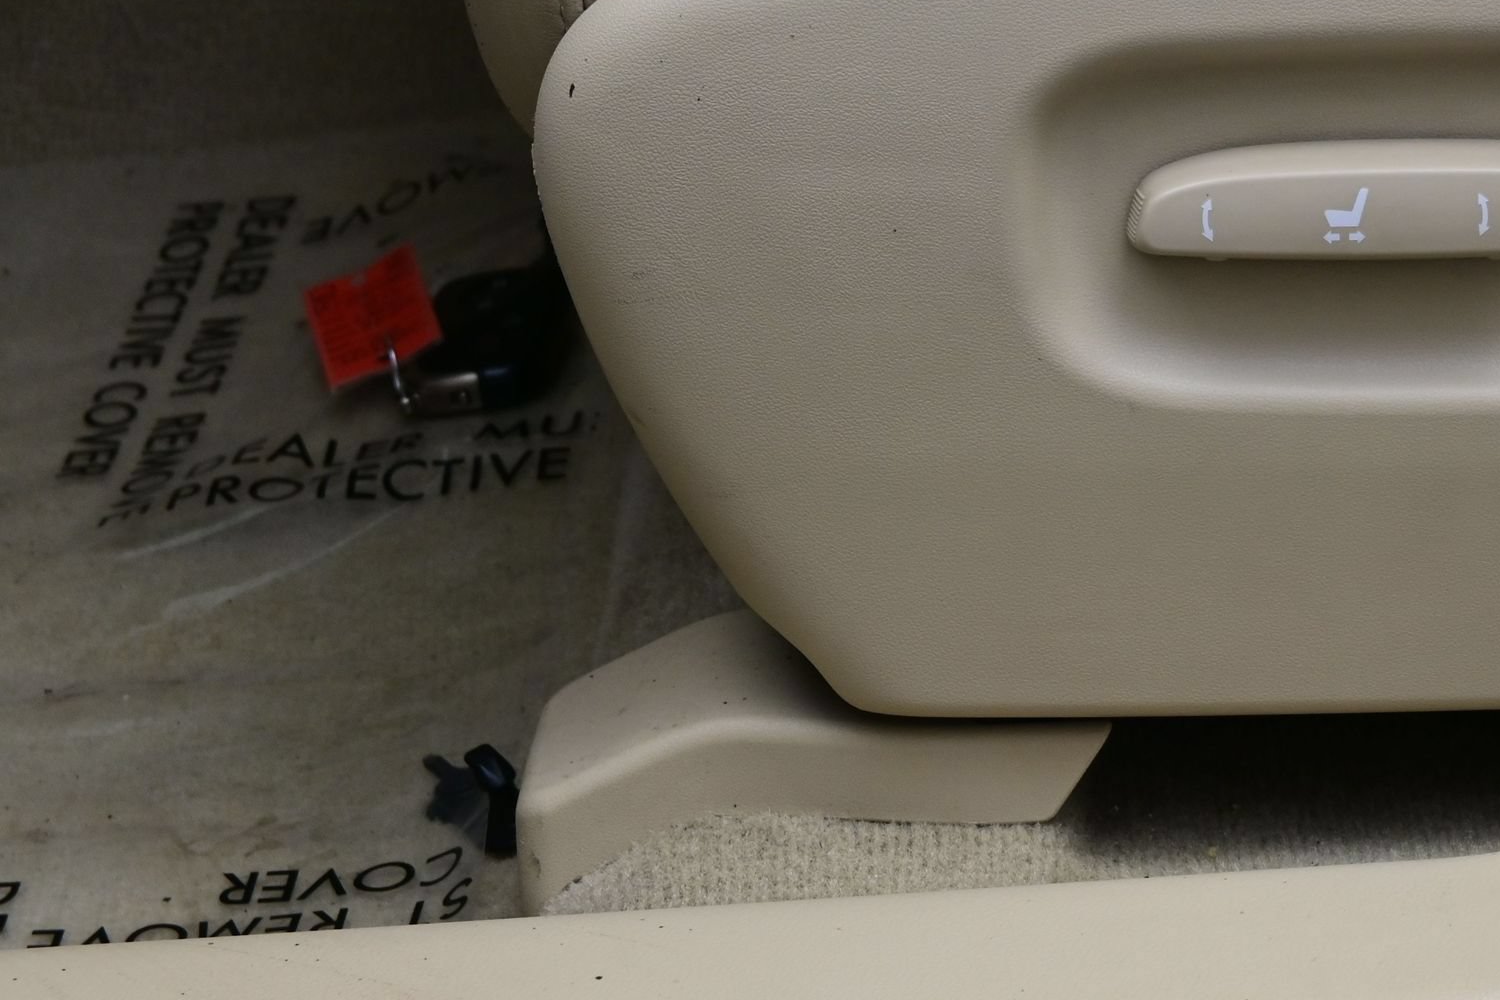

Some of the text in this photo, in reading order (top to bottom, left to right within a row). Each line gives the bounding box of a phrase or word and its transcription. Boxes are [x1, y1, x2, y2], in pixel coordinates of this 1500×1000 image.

[57, 200, 225, 481] PROTECTIVE COVER
[170, 315, 245, 397] MUST
[167, 445, 572, 514] PROTECTIVE
[219, 845, 463, 905] COVER
